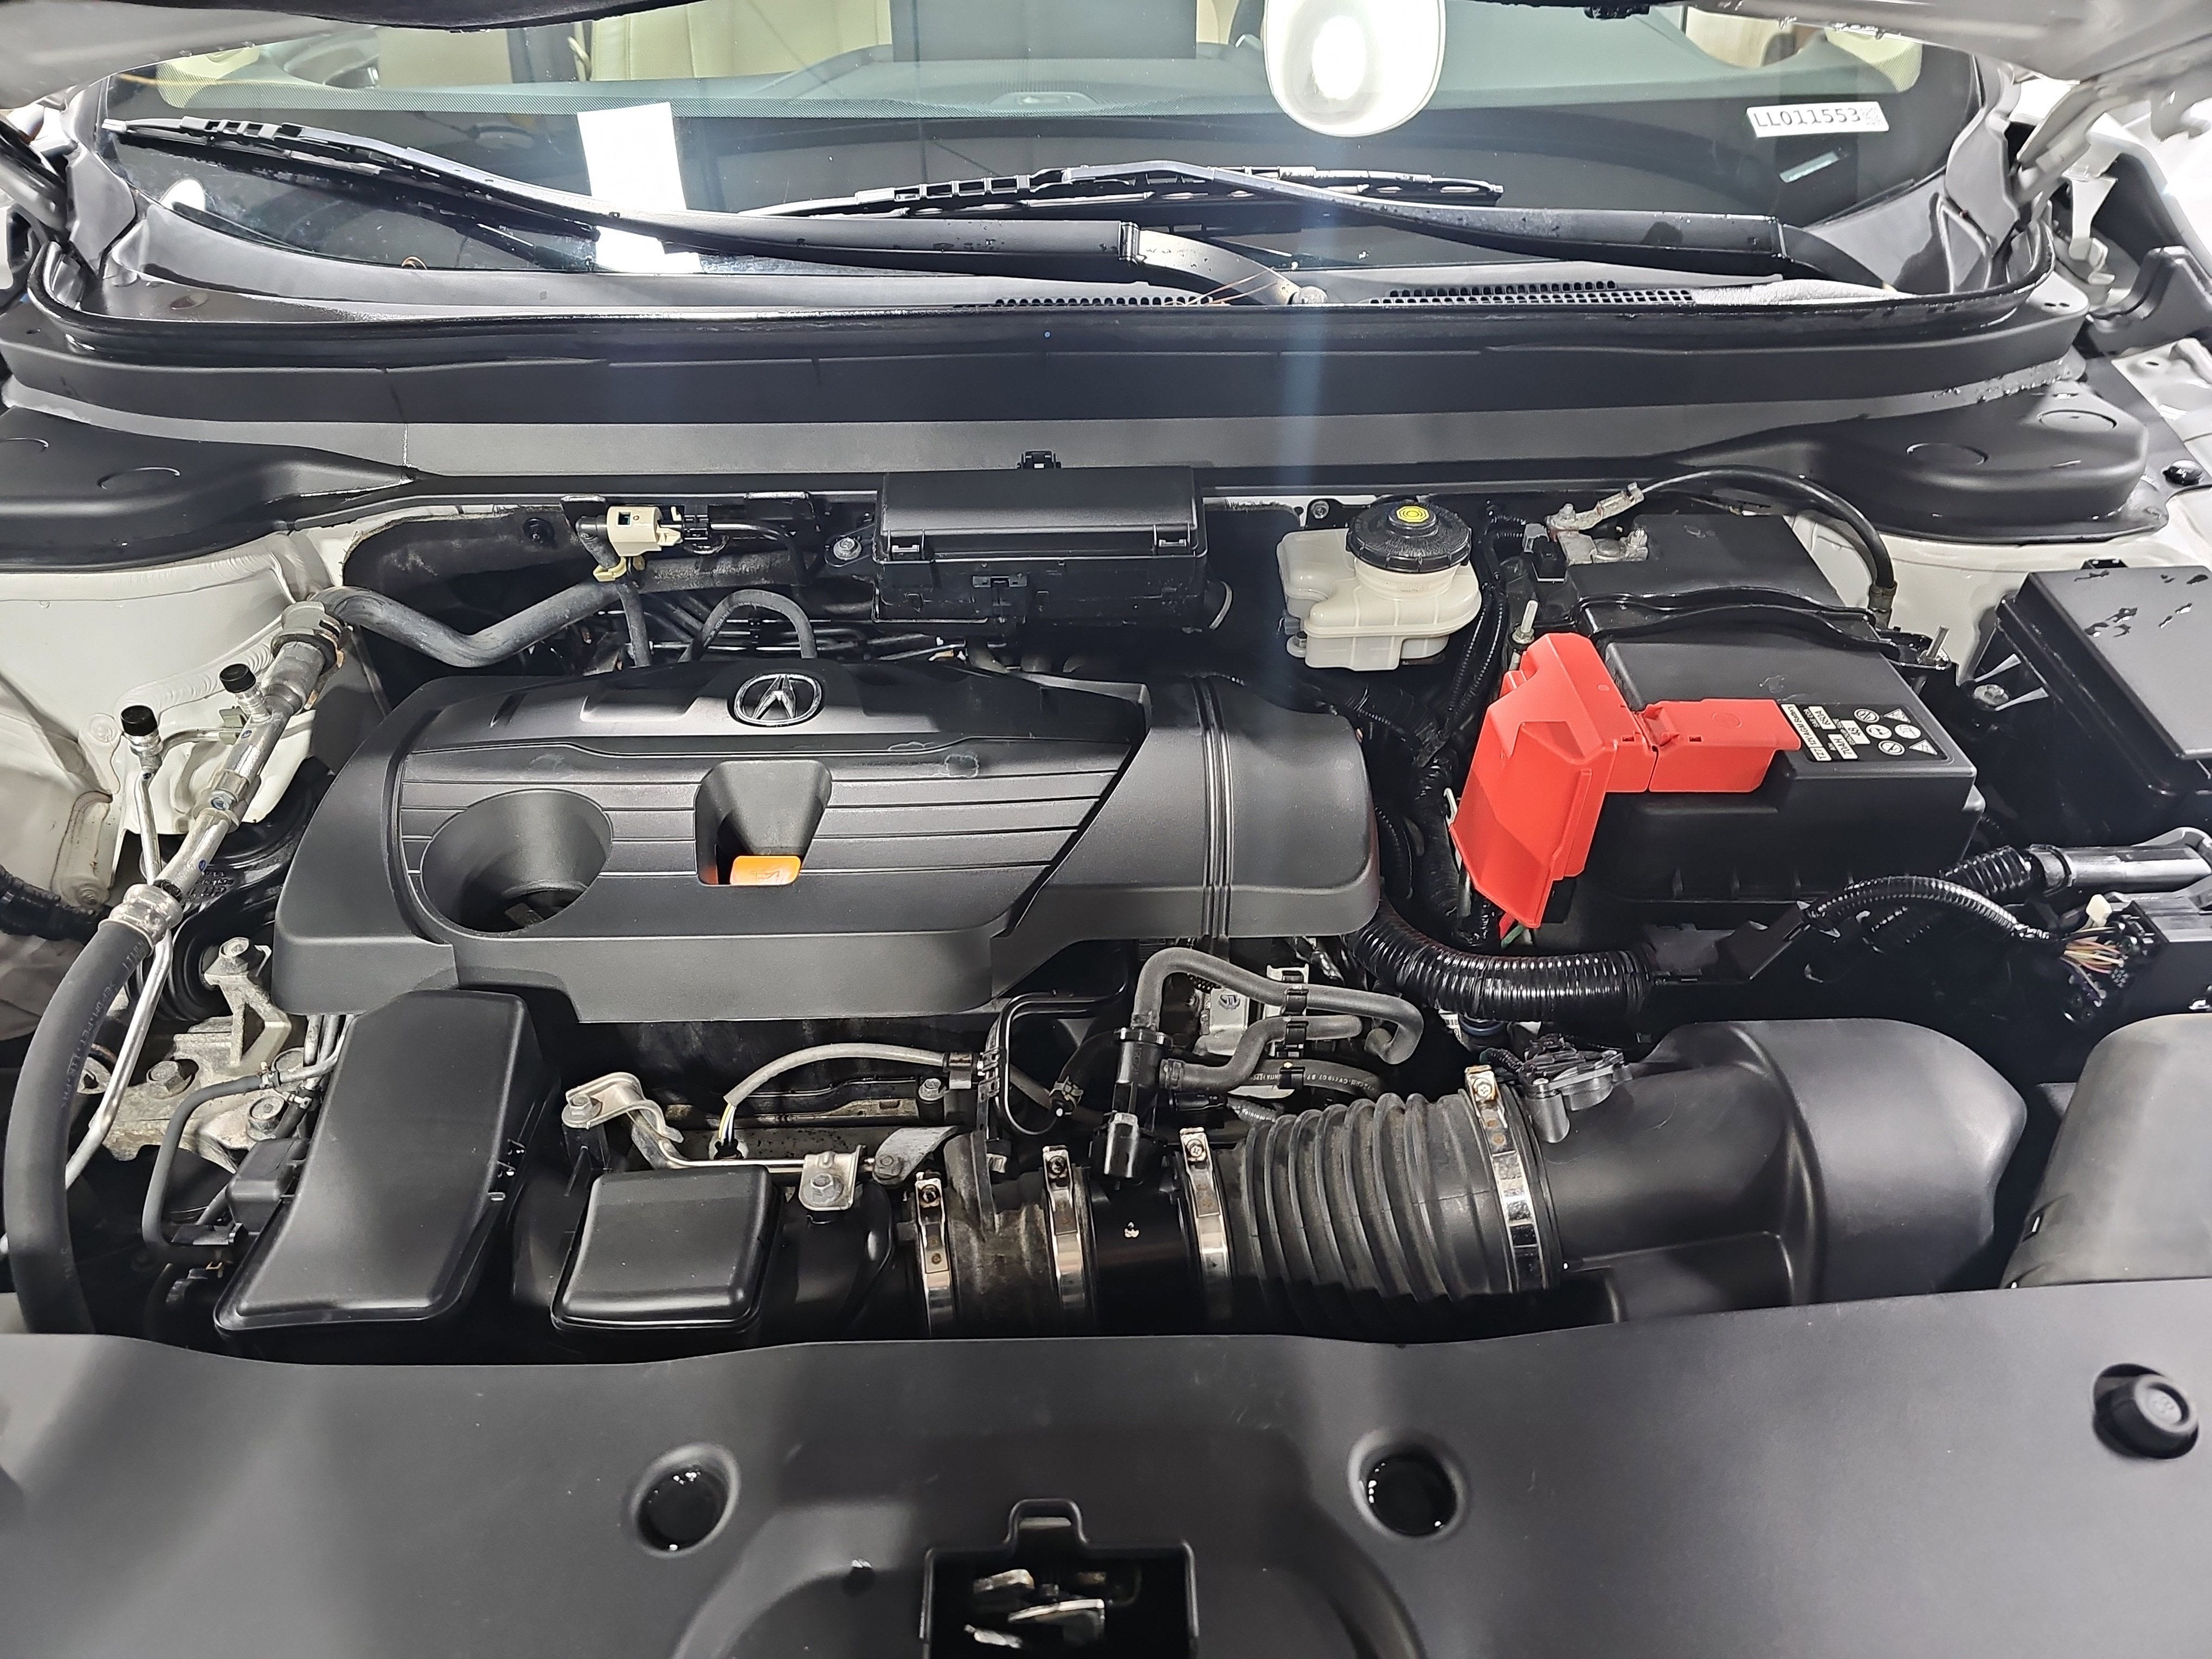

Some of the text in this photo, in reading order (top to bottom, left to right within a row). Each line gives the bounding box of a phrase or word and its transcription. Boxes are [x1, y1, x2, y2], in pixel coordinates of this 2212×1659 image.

[1753, 107, 1861, 127] LL011553
[1797, 723, 1811, 737] AGM
[1834, 738, 1852, 755] 70AH
